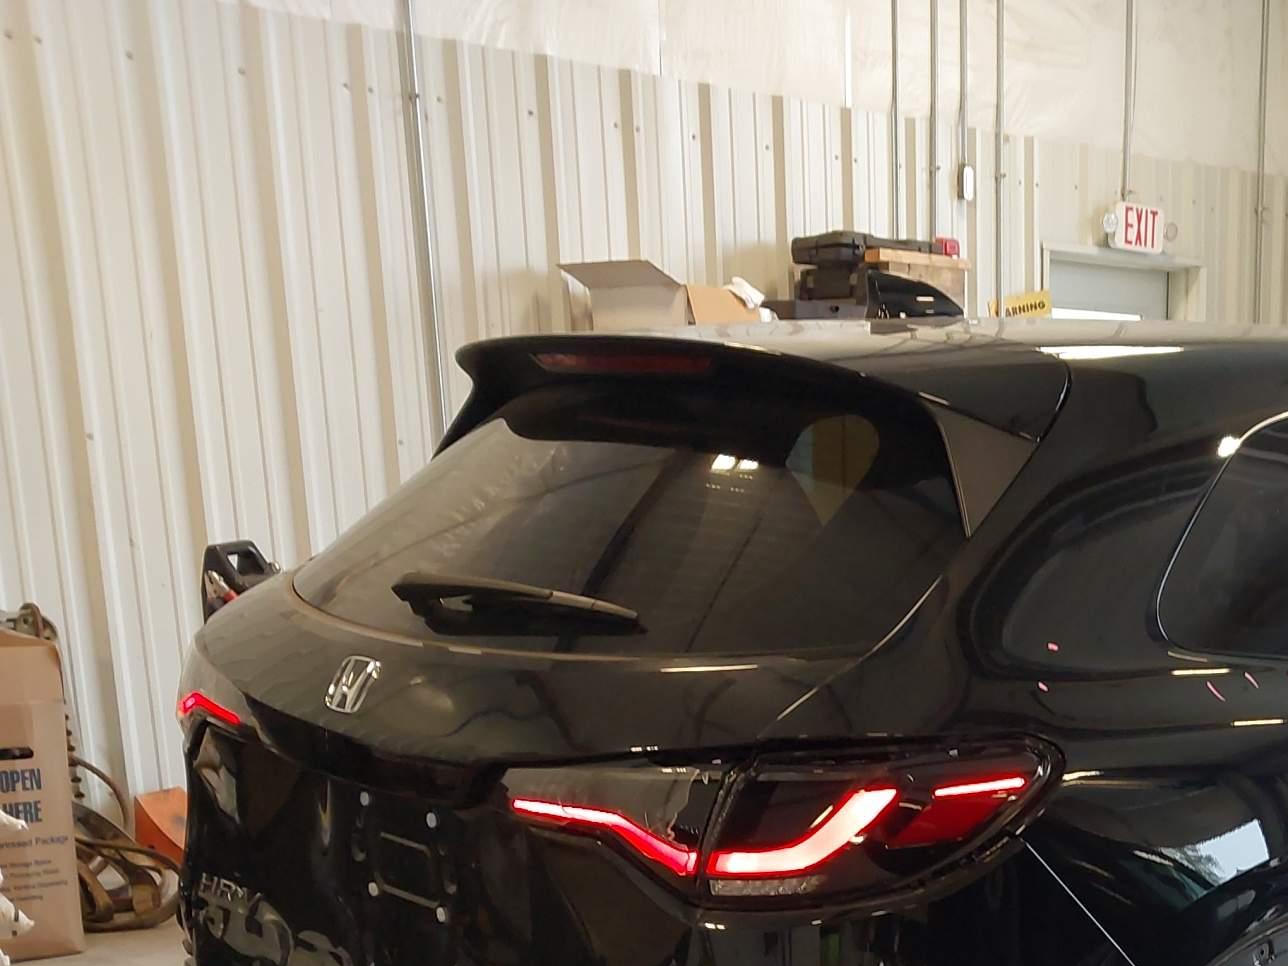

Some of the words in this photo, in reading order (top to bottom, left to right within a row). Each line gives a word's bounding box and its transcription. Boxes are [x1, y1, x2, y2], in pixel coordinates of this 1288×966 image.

[1124, 206, 1159, 249] EXIT
[994, 300, 1046, 318] ARNING
[0, 768, 42, 793] OPEN
[2, 801, 43, 823] HERE
